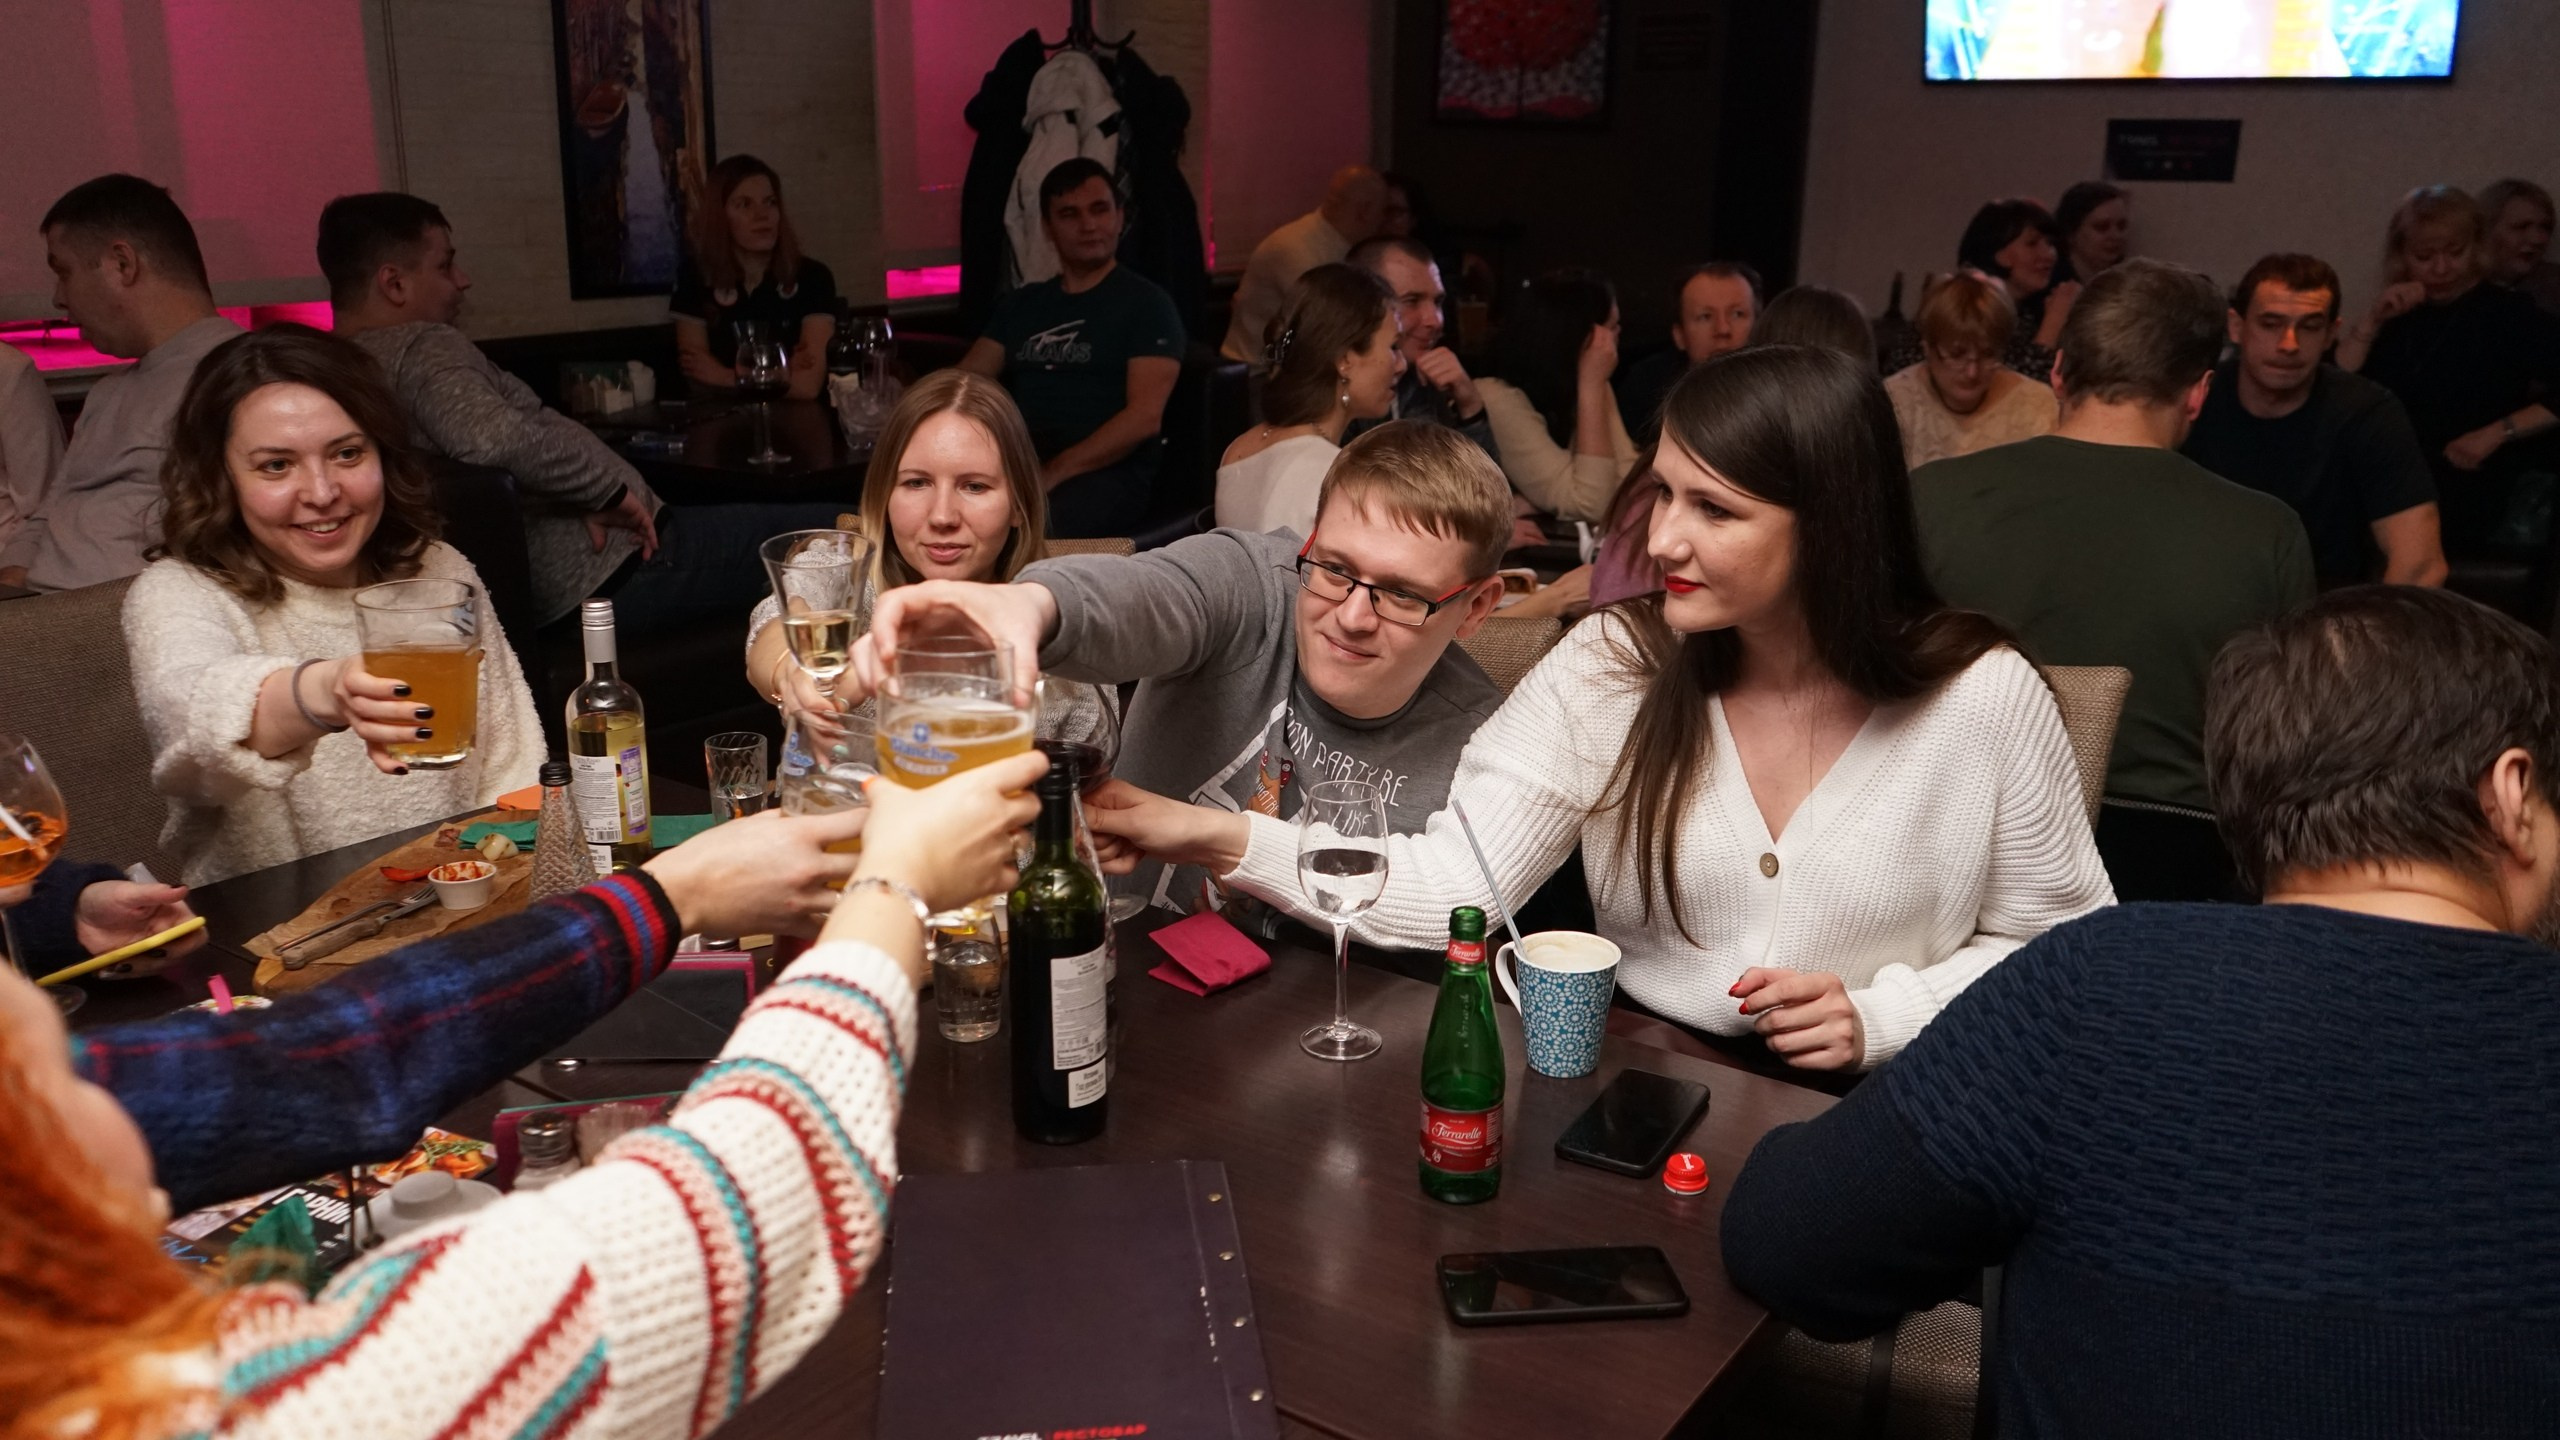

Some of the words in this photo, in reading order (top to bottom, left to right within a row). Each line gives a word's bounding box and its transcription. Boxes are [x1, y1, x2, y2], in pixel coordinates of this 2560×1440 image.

[1312, 741, 1379, 799] PARTY
[1378, 769, 1408, 807] BE
[1331, 806, 1373, 837] LIKE
[1431, 1121, 1482, 1144] Ferrarelle
